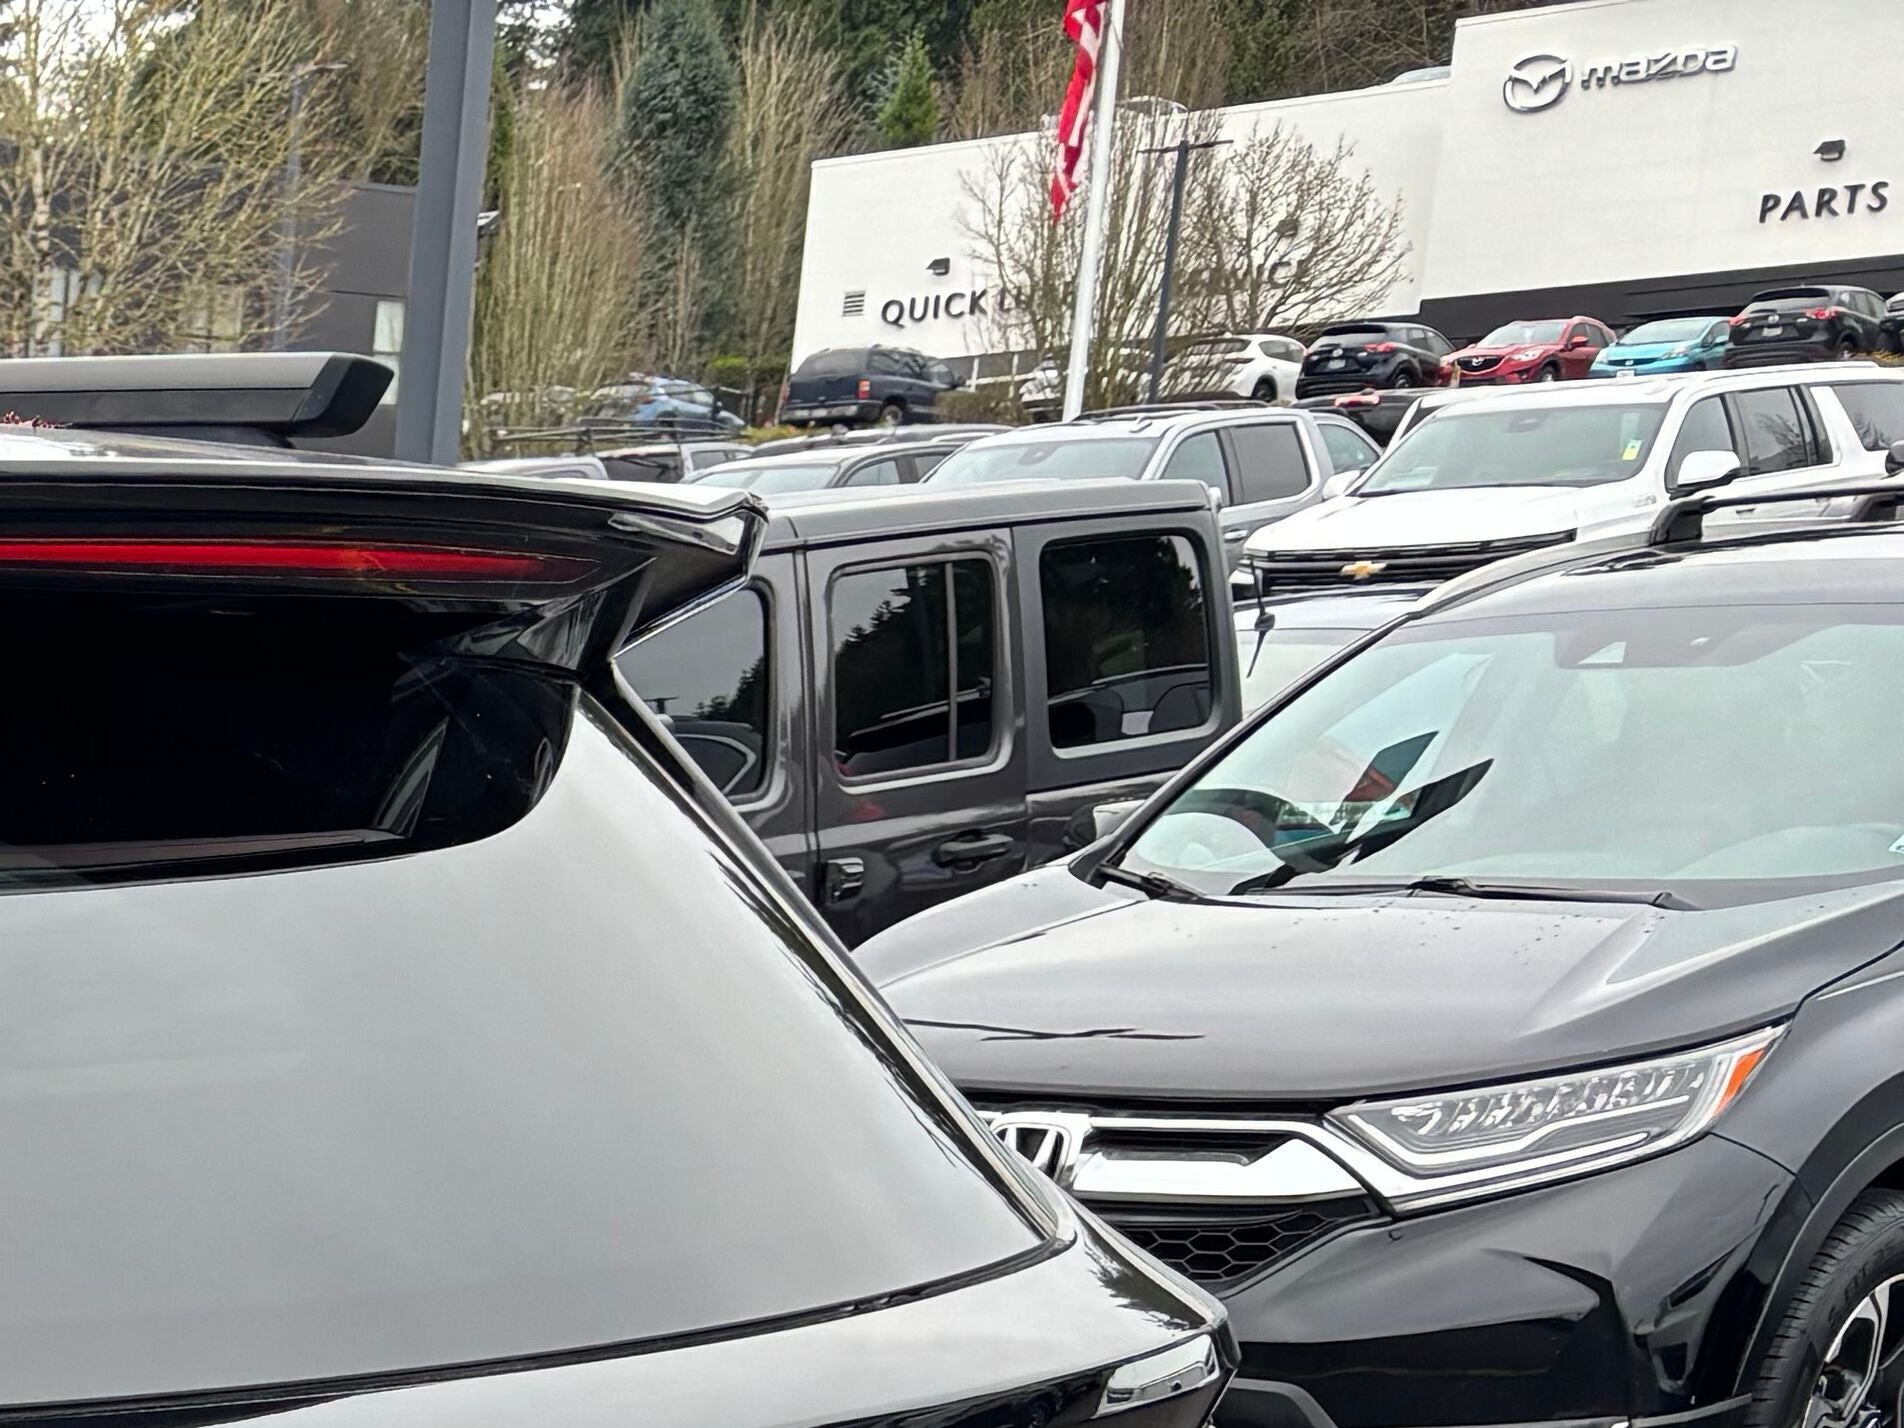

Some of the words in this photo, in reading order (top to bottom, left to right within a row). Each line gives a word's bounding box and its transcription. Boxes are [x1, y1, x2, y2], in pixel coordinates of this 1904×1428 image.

[1581, 43, 1738, 90] mazda
[1758, 180, 1889, 224] PARTS
[881, 288, 988, 328] QUICK
